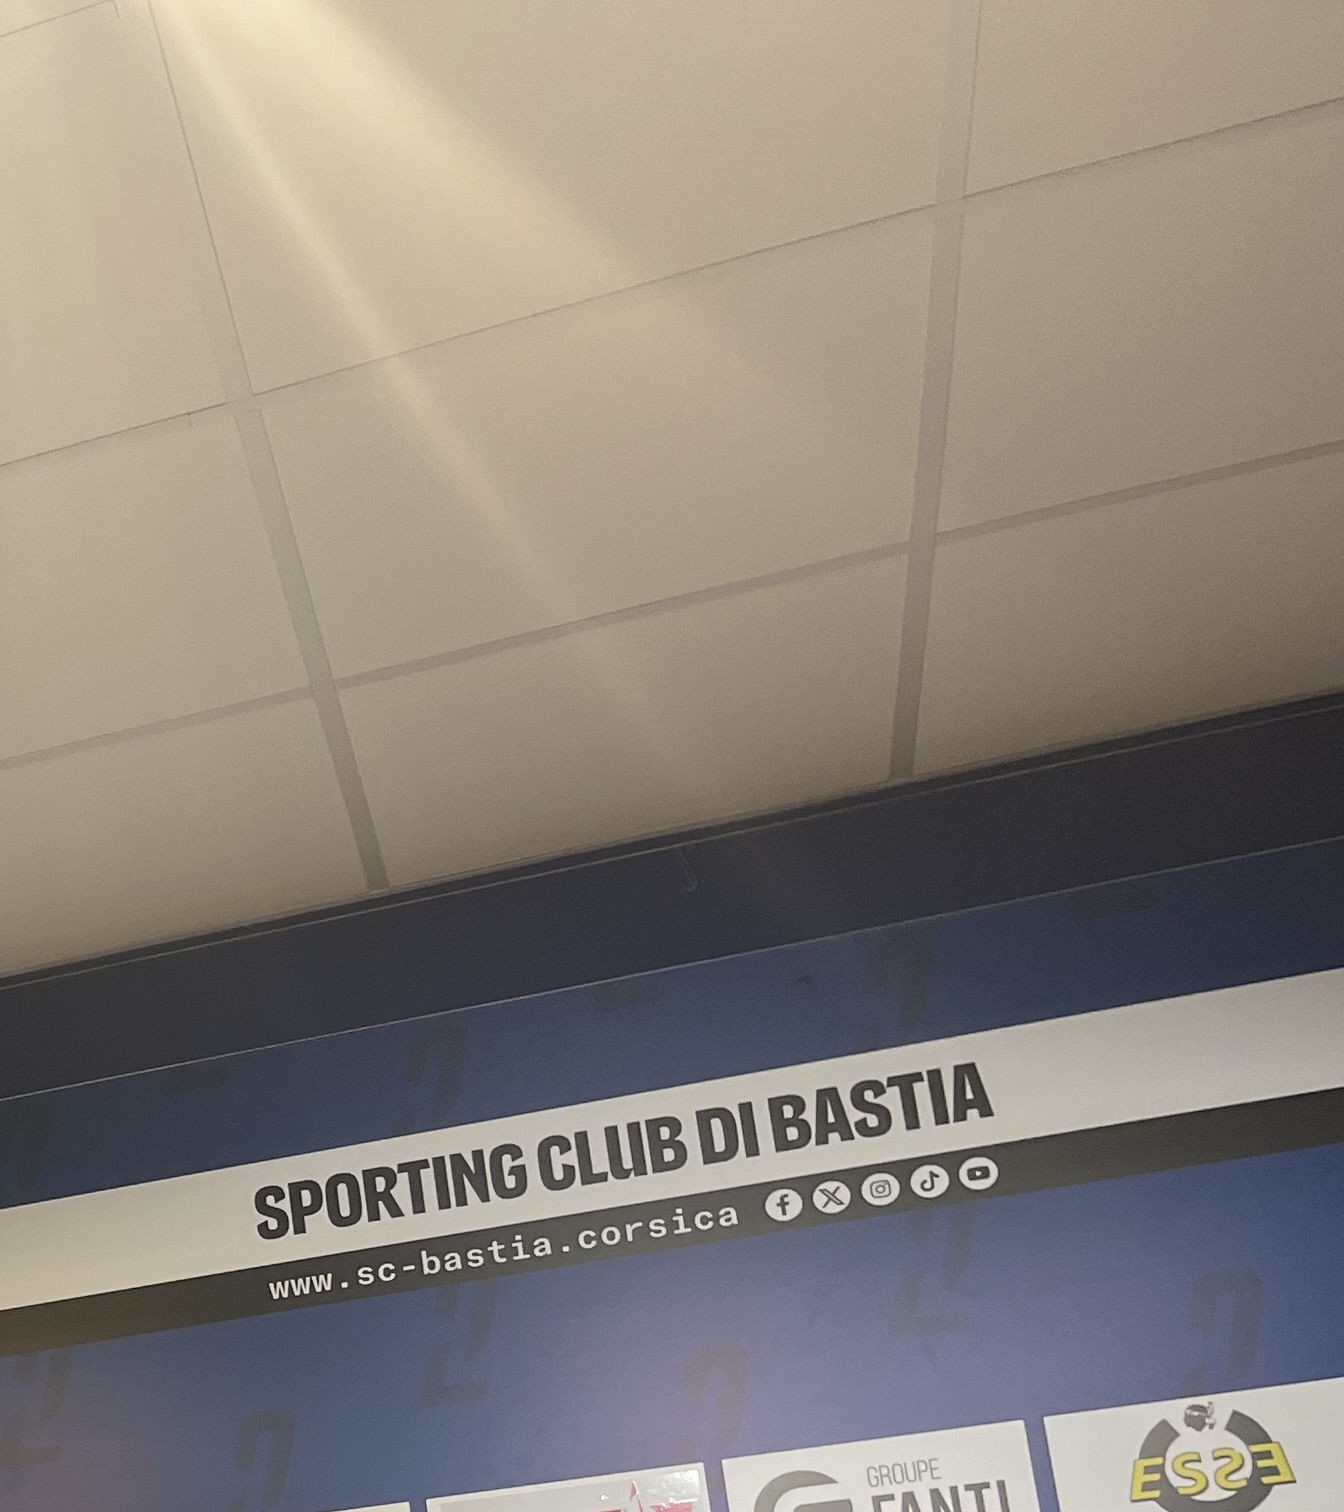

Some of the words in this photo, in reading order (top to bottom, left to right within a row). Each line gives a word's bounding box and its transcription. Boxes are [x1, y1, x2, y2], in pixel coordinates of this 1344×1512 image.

[254, 1144, 527, 1240] SPORTING
[537, 1116, 687, 1191] CLUB
[695, 1102, 760, 1165] DI
[768, 1062, 994, 1152] BASTIA
[268, 1205, 738, 1300] www.sc-bastia.corsica
[867, 1458, 942, 1488] GROUPE
